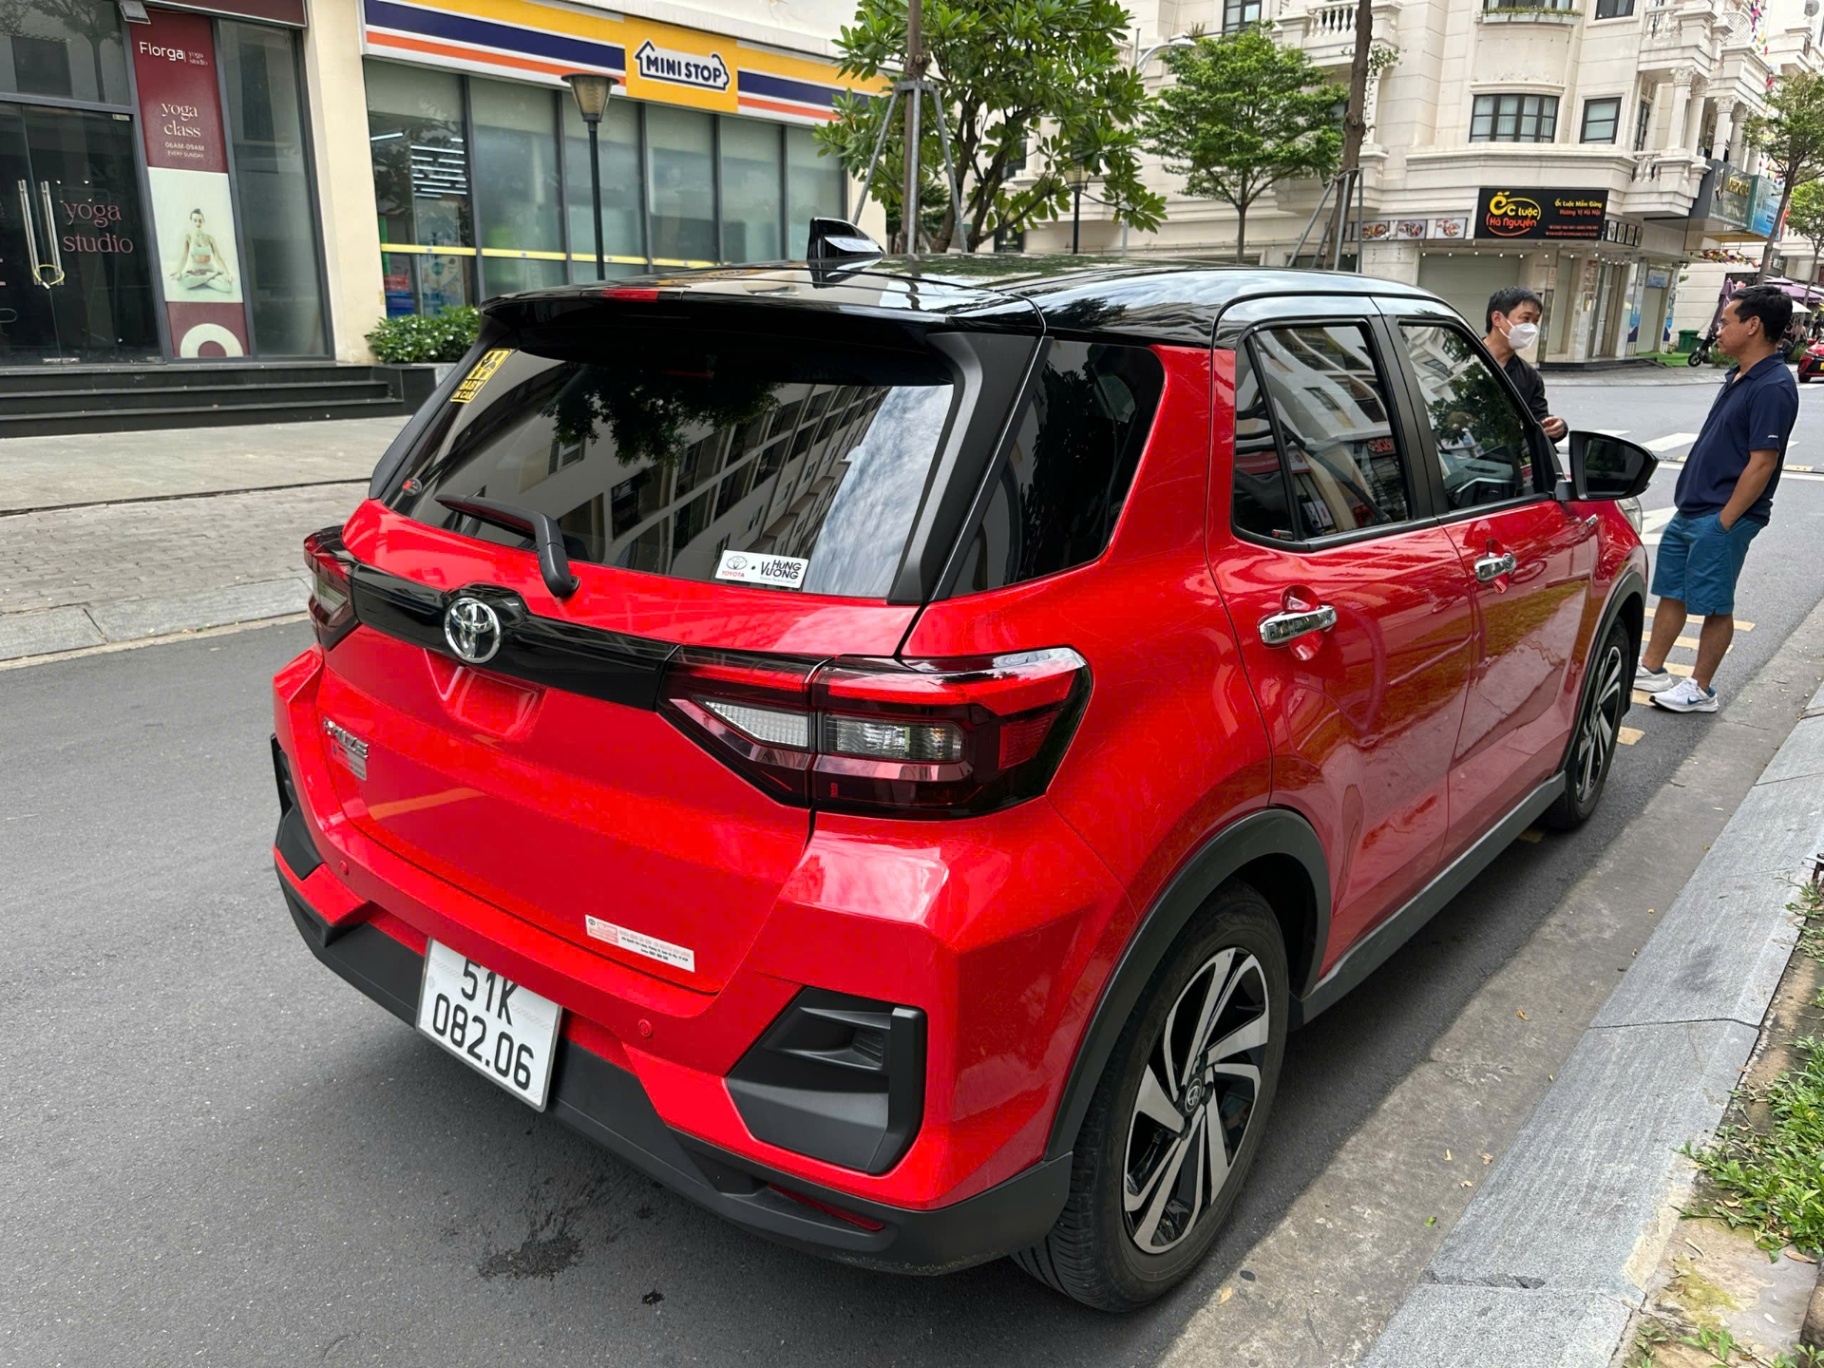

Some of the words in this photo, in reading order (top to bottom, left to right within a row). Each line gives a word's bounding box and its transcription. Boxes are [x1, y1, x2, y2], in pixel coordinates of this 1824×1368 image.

[139, 41, 185, 61] Florga
[646, 54, 682, 77] MINI
[684, 62, 722, 83] STOP
[161, 103, 198, 121] yoga
[163, 120, 201, 138] class
[63, 202, 122, 228] yoga
[63, 232, 134, 254] studio
[721, 570, 745, 578] TOYOTA
[461, 958, 519, 1027] 51K
[432, 993, 535, 1091] 082.06
